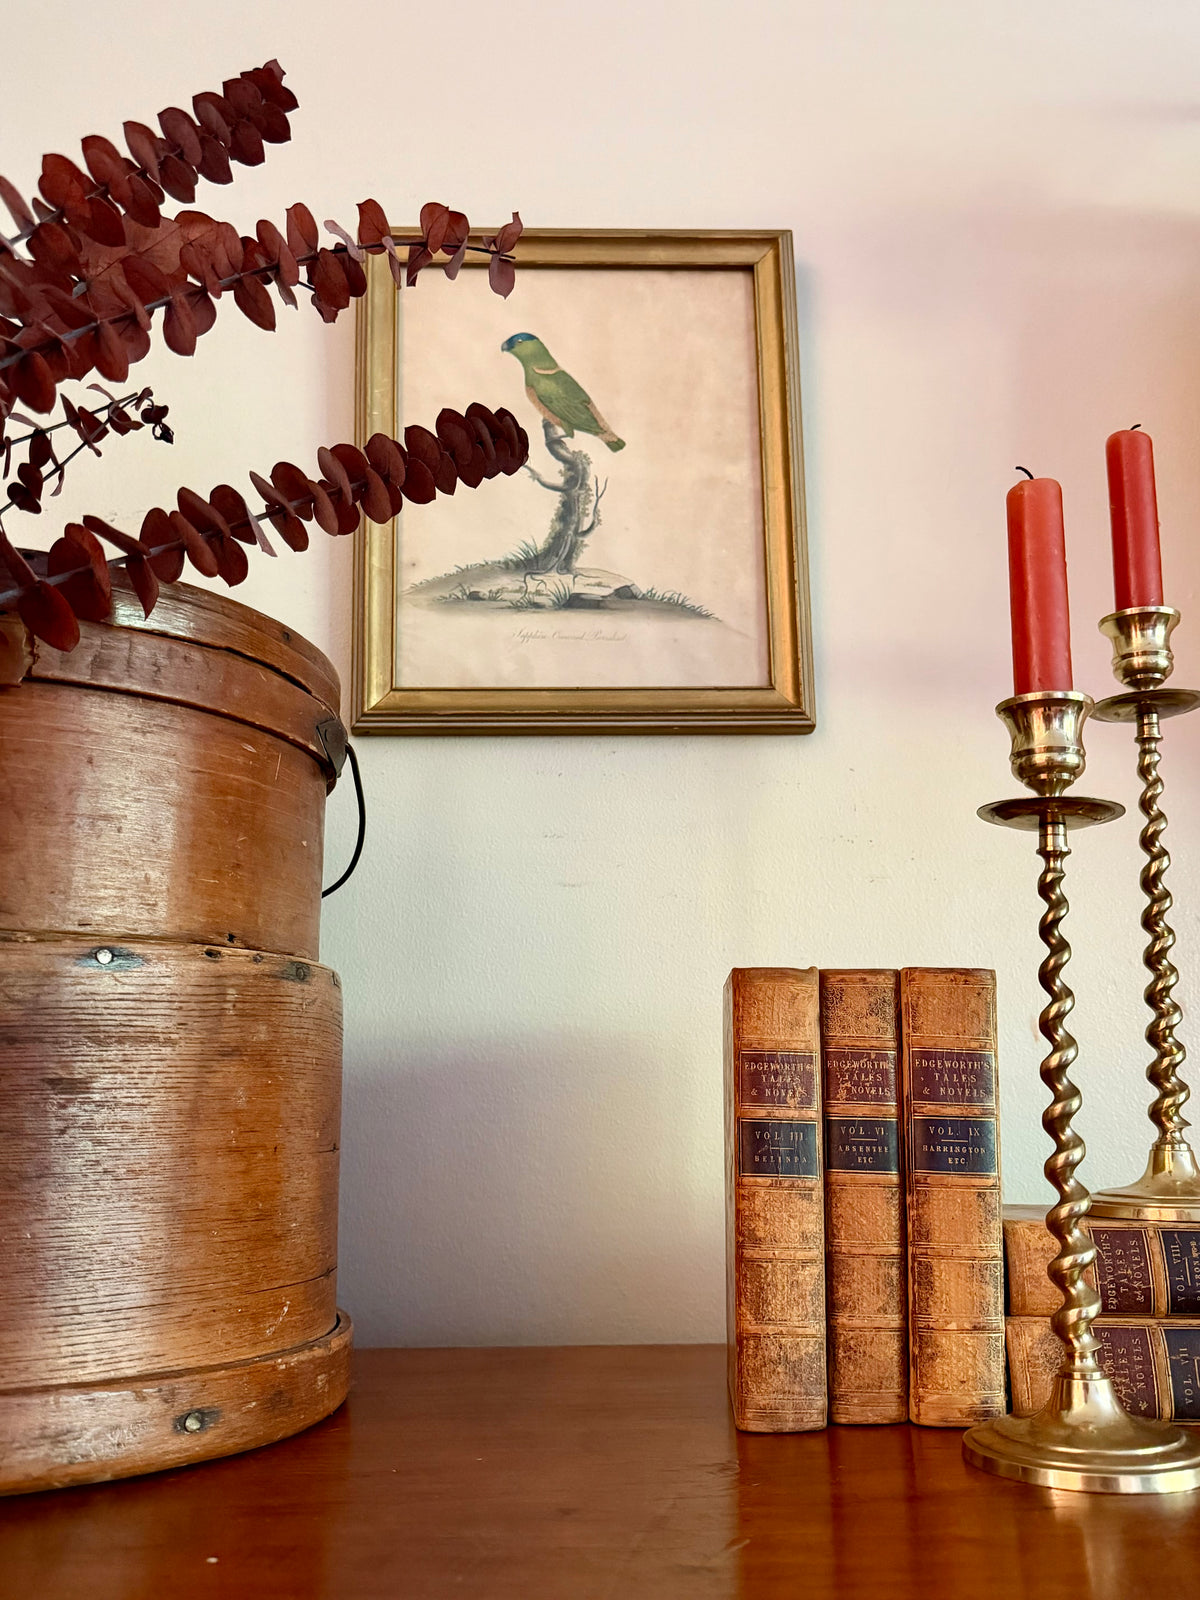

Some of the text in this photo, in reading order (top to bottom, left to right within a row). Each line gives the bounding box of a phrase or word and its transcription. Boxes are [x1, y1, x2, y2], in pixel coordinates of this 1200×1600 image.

[915, 1058, 991, 1070] EDGEWORTH'S
[761, 1074, 801, 1083] TALES
[843, 1073, 883, 1082] TALES
[933, 1072, 977, 1083] TALES
[750, 1087, 758, 1096] &
[922, 1086, 931, 1096] &
[840, 1126, 871, 1136] VOL.
[838, 1145, 889, 1153] ABSENTEE
[922, 1144, 987, 1155] HARRINGTON
[1100, 1233, 1117, 1310] EDGEWORTH'S
[1117, 1249, 1129, 1293] TALES
[1174, 1269, 1185, 1302] VOL.
